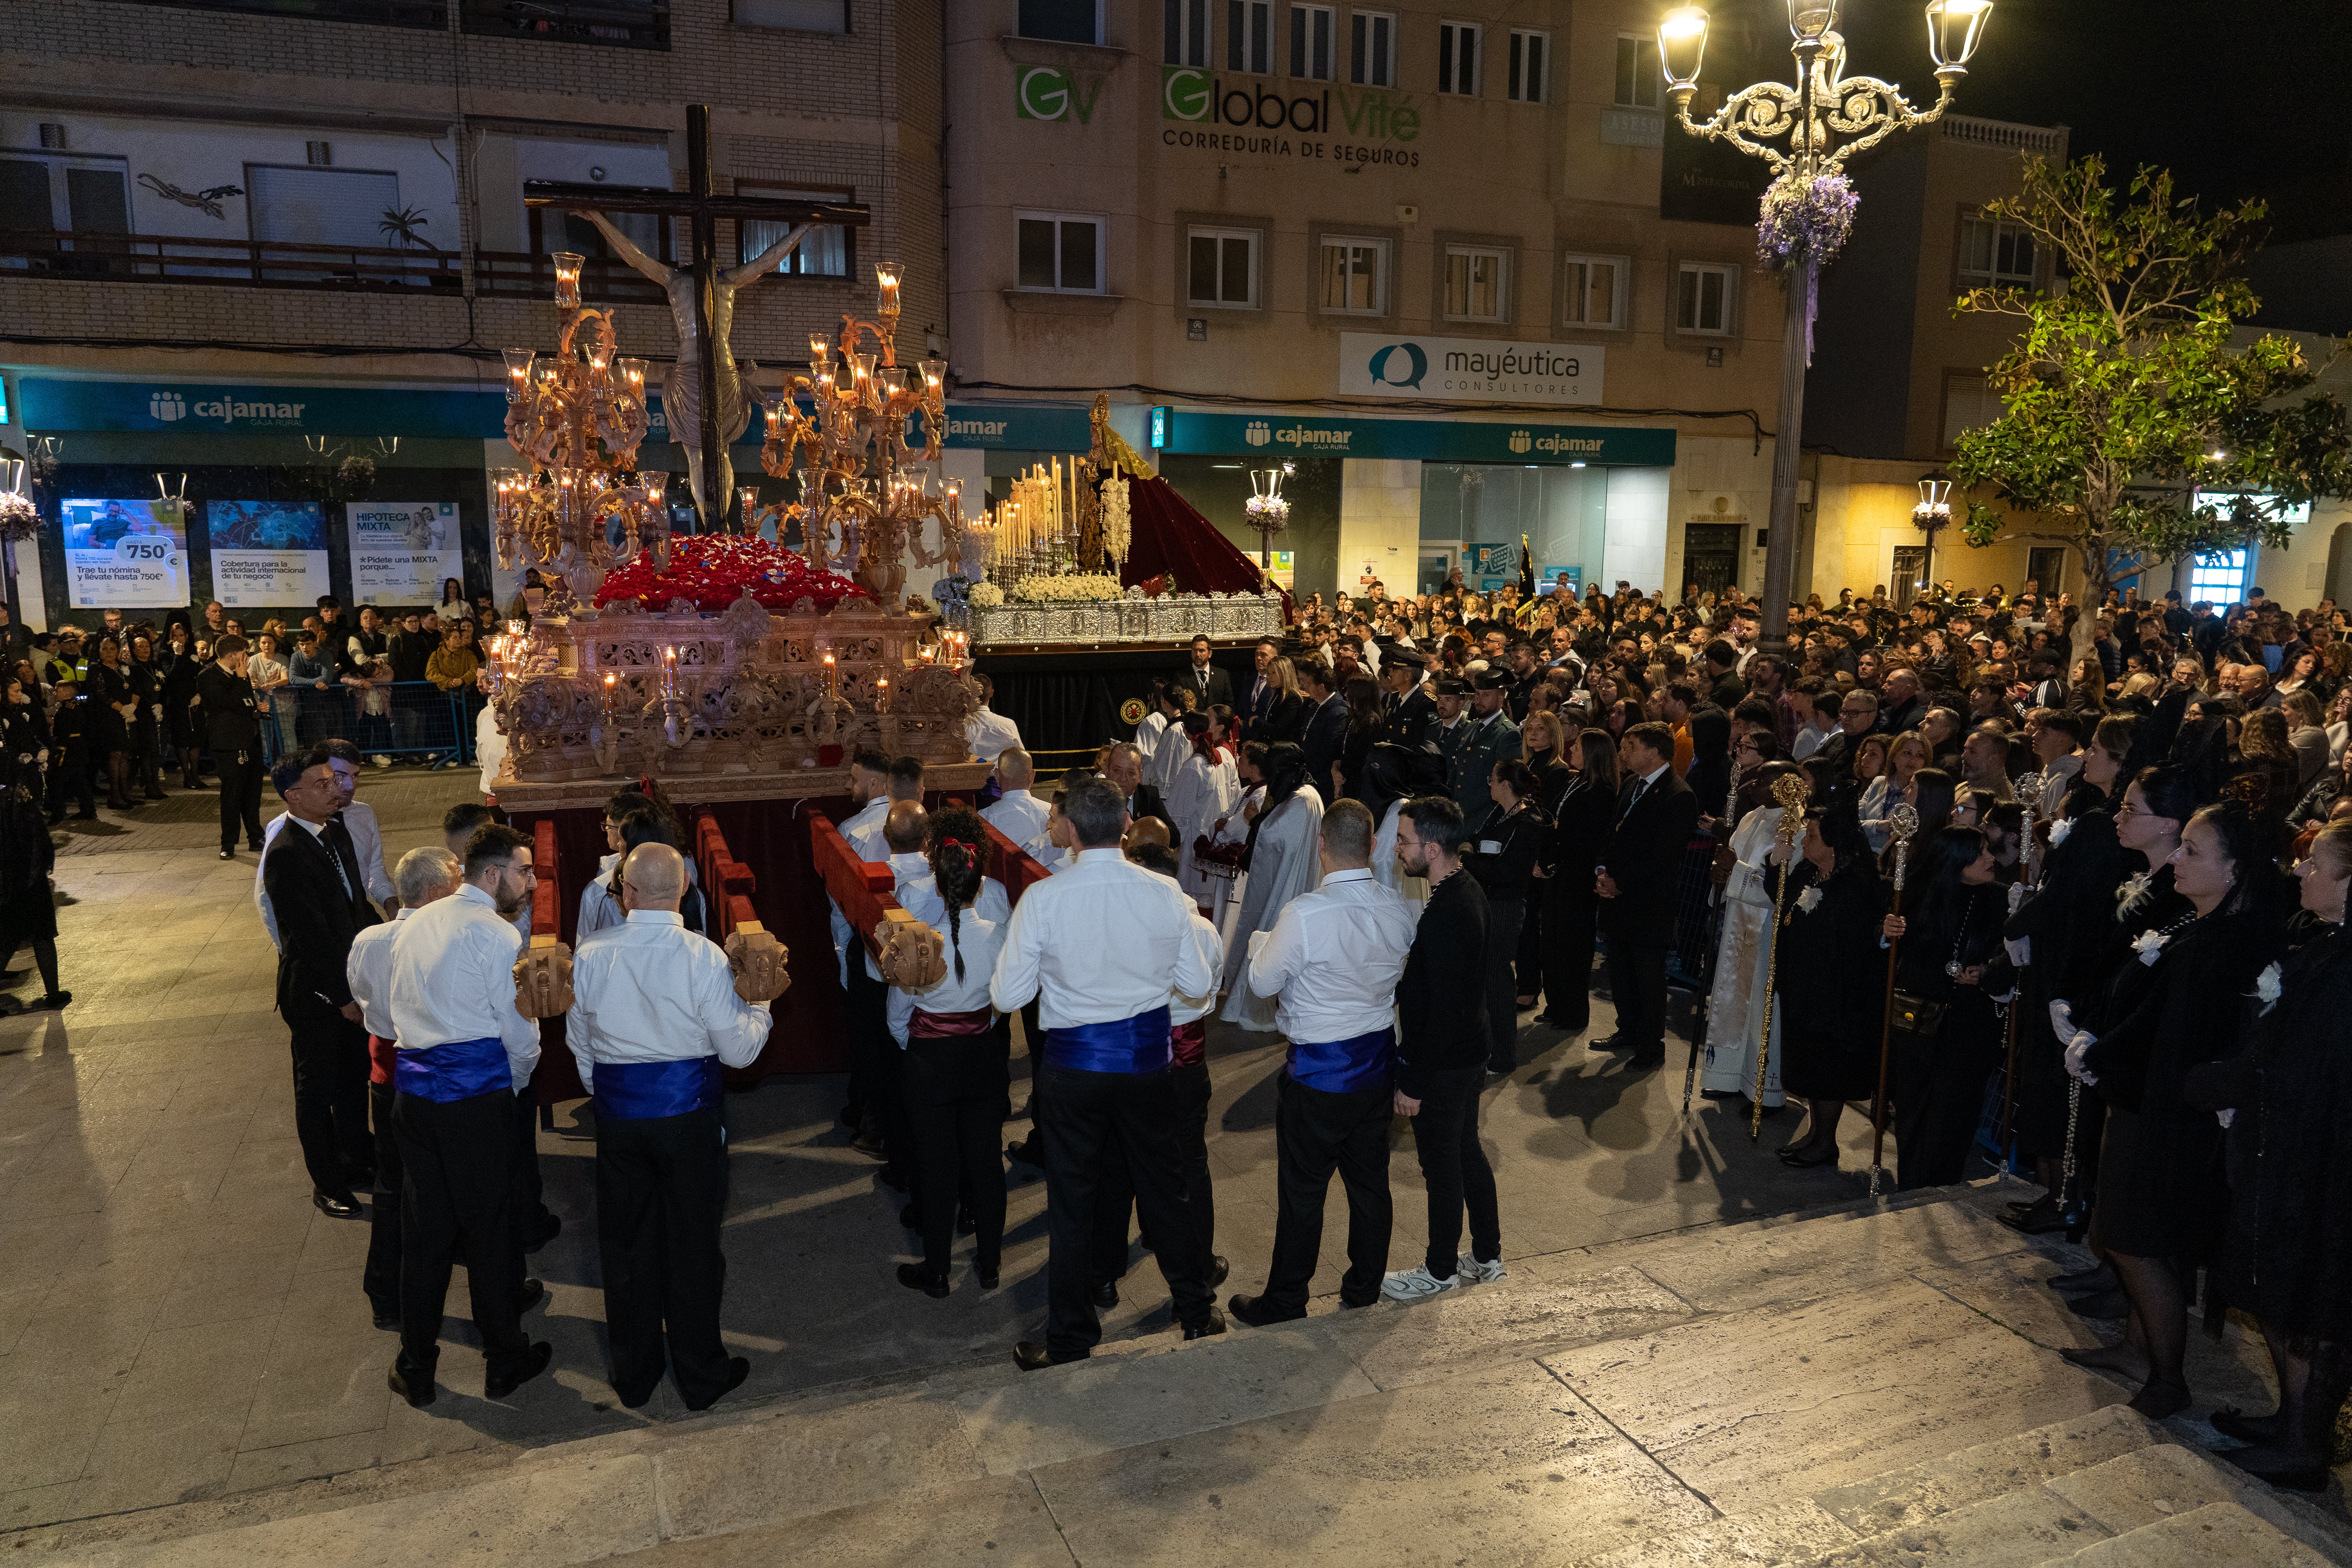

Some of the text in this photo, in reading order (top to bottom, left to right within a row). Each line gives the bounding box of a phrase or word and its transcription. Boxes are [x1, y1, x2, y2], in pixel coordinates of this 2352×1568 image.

[1166, 70, 1328, 133] Global
[1163, 130, 1419, 167] CORREDURÍA DE SEGUROS
[1445, 347, 1579, 381] mayéutica
[1445, 380, 1578, 395] CONSULTORES
[194, 396, 306, 424] cajamar
[919, 415, 1007, 439] cjamar
[1276, 425, 1352, 448] cajamar
[1536, 434, 1604, 455] cajamar
[356, 513, 410, 521] HIPOTECA
[357, 522, 391, 530] MIXTA
